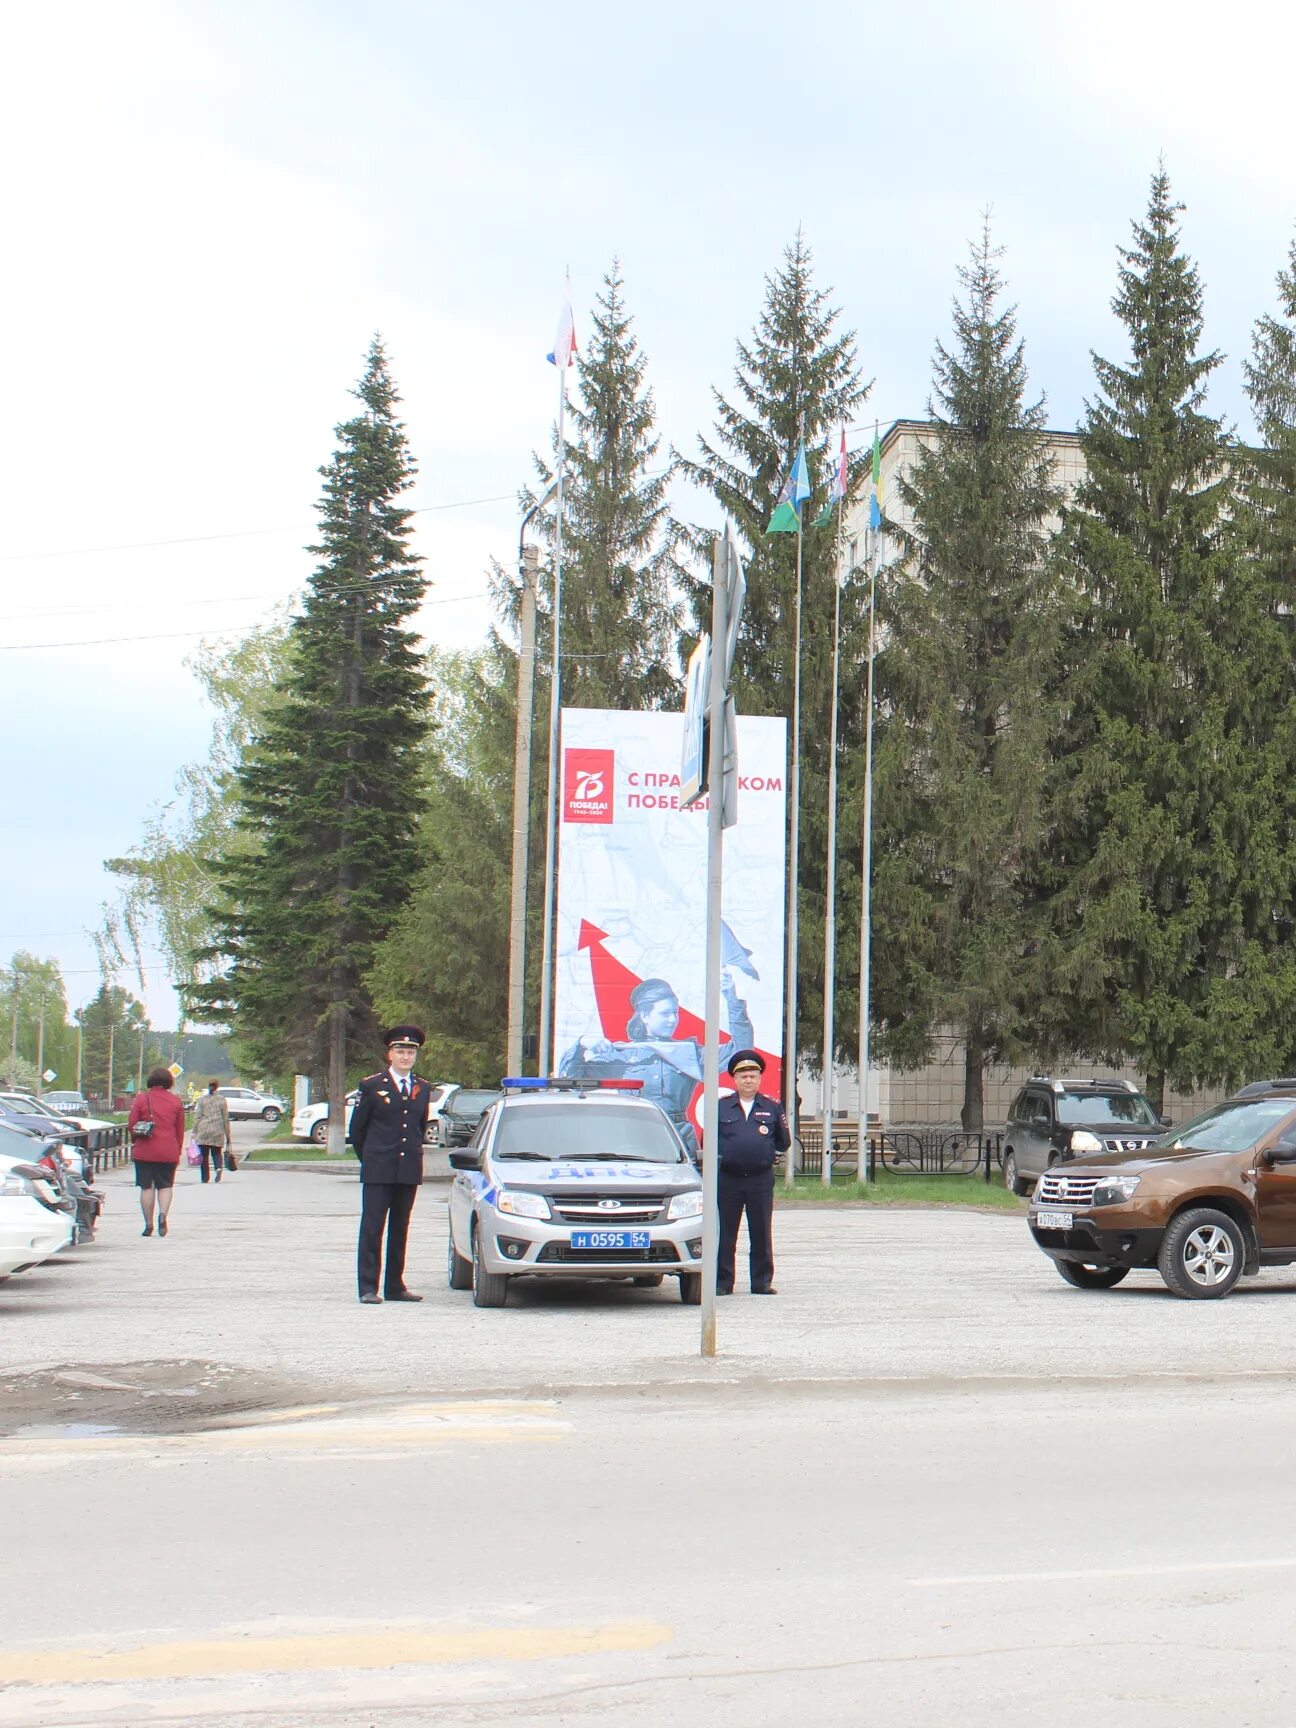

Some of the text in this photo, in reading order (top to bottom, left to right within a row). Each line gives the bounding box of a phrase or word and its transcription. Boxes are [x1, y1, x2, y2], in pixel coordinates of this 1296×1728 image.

[628, 772, 782, 791] С ПРАКОМ
[548, 1167, 655, 1180] ДПС
[591, 1233, 625, 1247] 0595
[632, 1232, 646, 1243] 54
